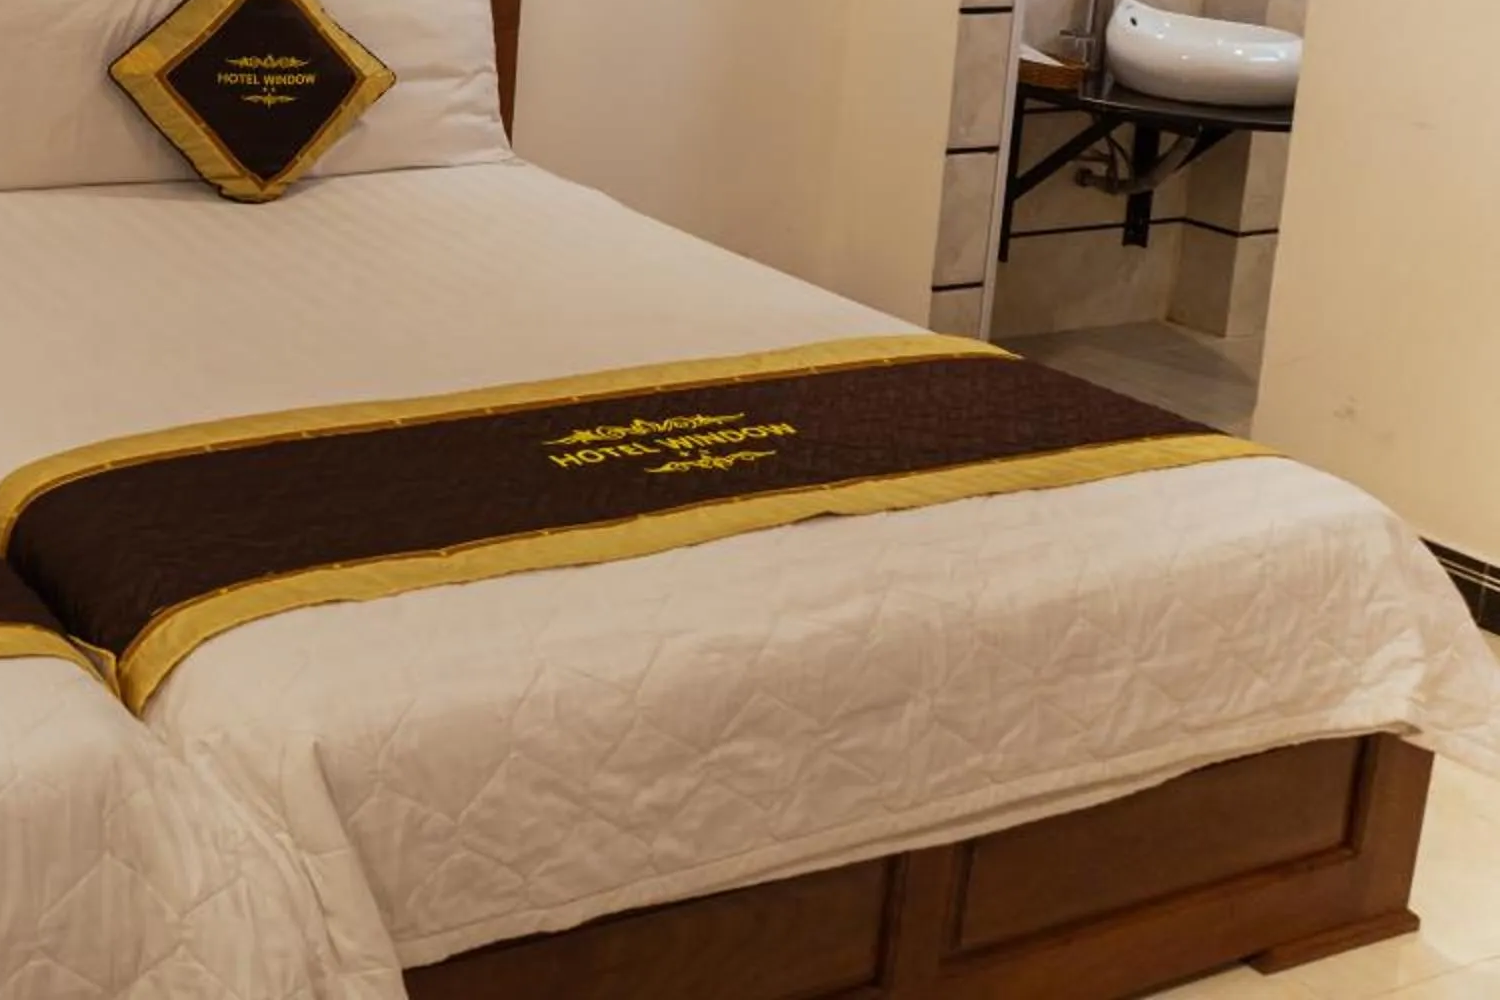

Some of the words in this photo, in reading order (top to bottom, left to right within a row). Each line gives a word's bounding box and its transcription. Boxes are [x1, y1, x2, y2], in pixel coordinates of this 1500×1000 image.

[217, 73, 260, 85] HOTEL
[263, 73, 316, 85] WINDOW
[549, 442, 660, 468] HOTEL
[655, 422, 797, 450] WINDOW
